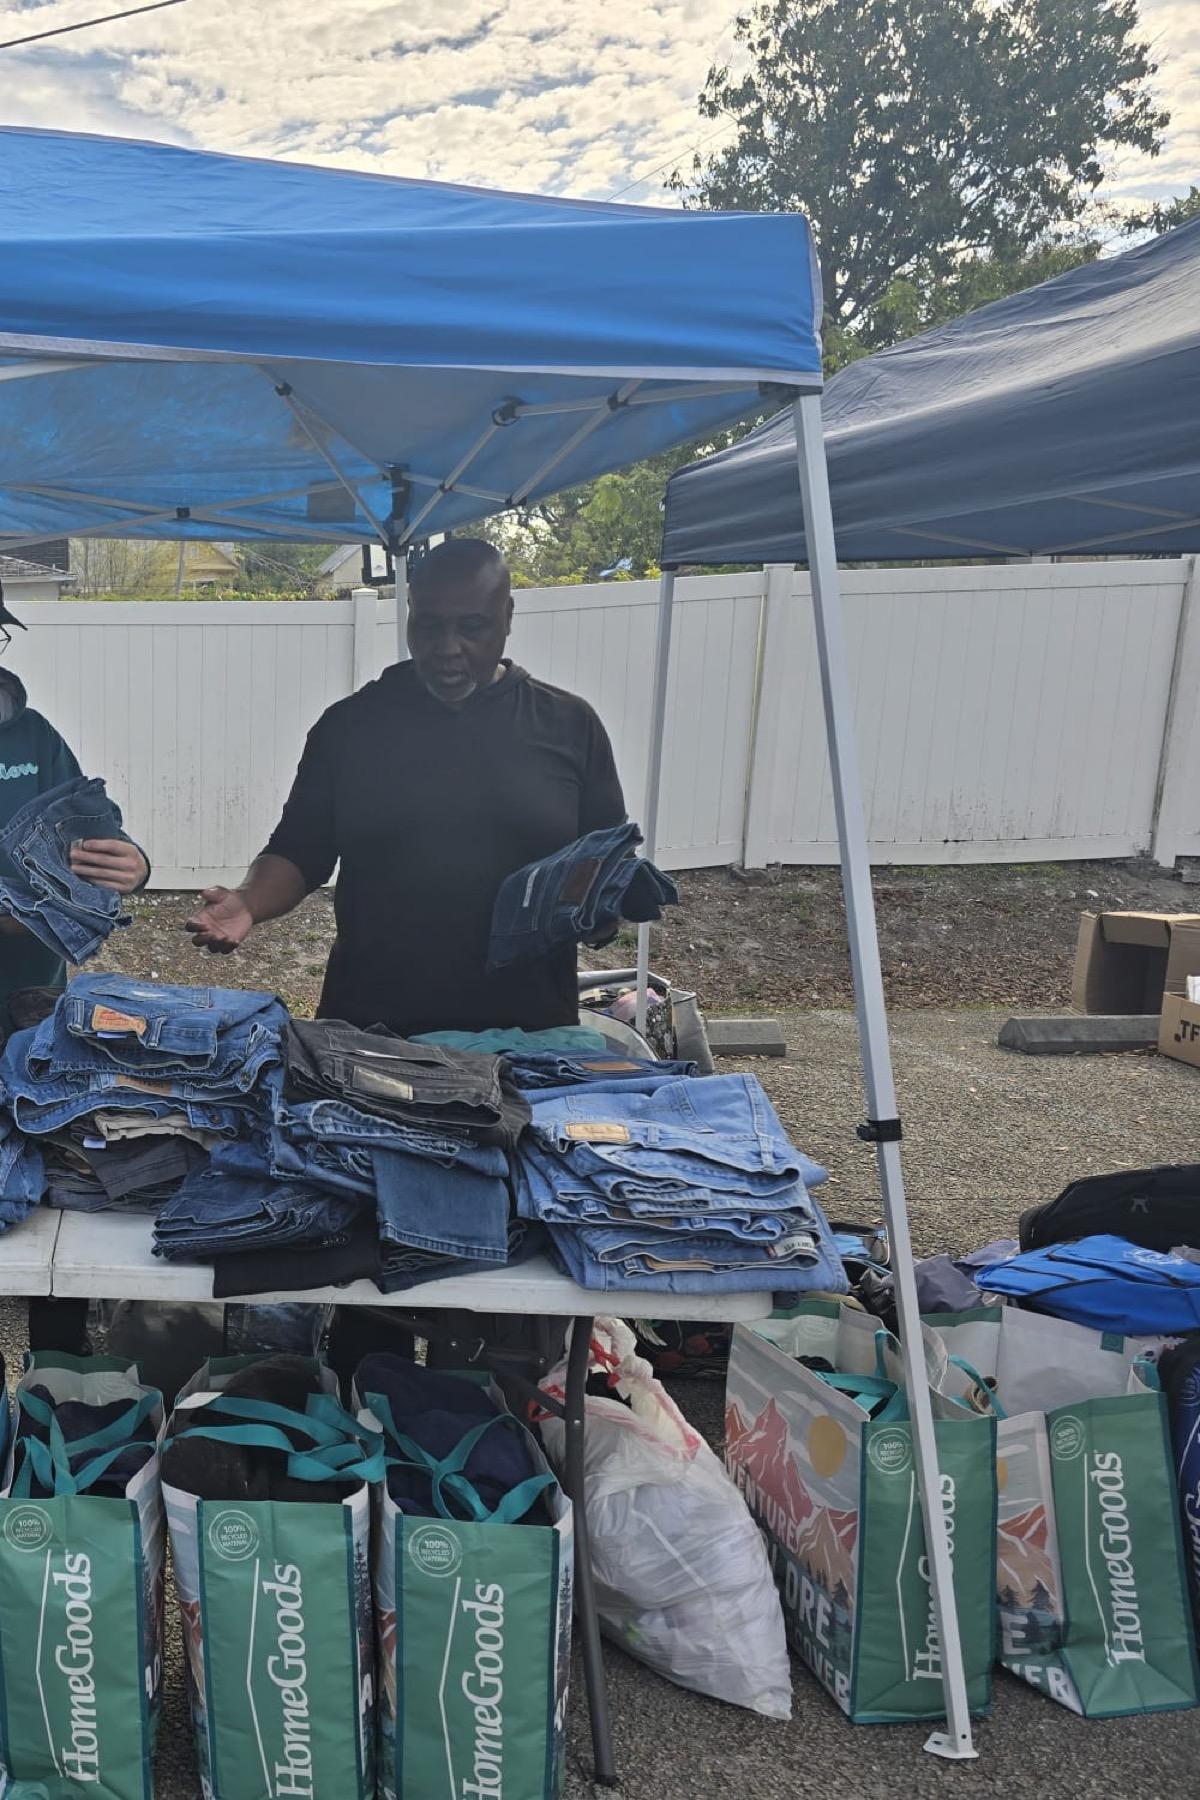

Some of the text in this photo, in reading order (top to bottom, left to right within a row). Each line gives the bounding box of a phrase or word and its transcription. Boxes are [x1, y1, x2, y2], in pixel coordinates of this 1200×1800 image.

[53, 1553, 100, 1784] HomeGoods
[1090, 1452, 1146, 1665] HomeGoods
[262, 1564, 313, 1799] HomeGoods
[461, 1583, 504, 1800] HomeGoods
